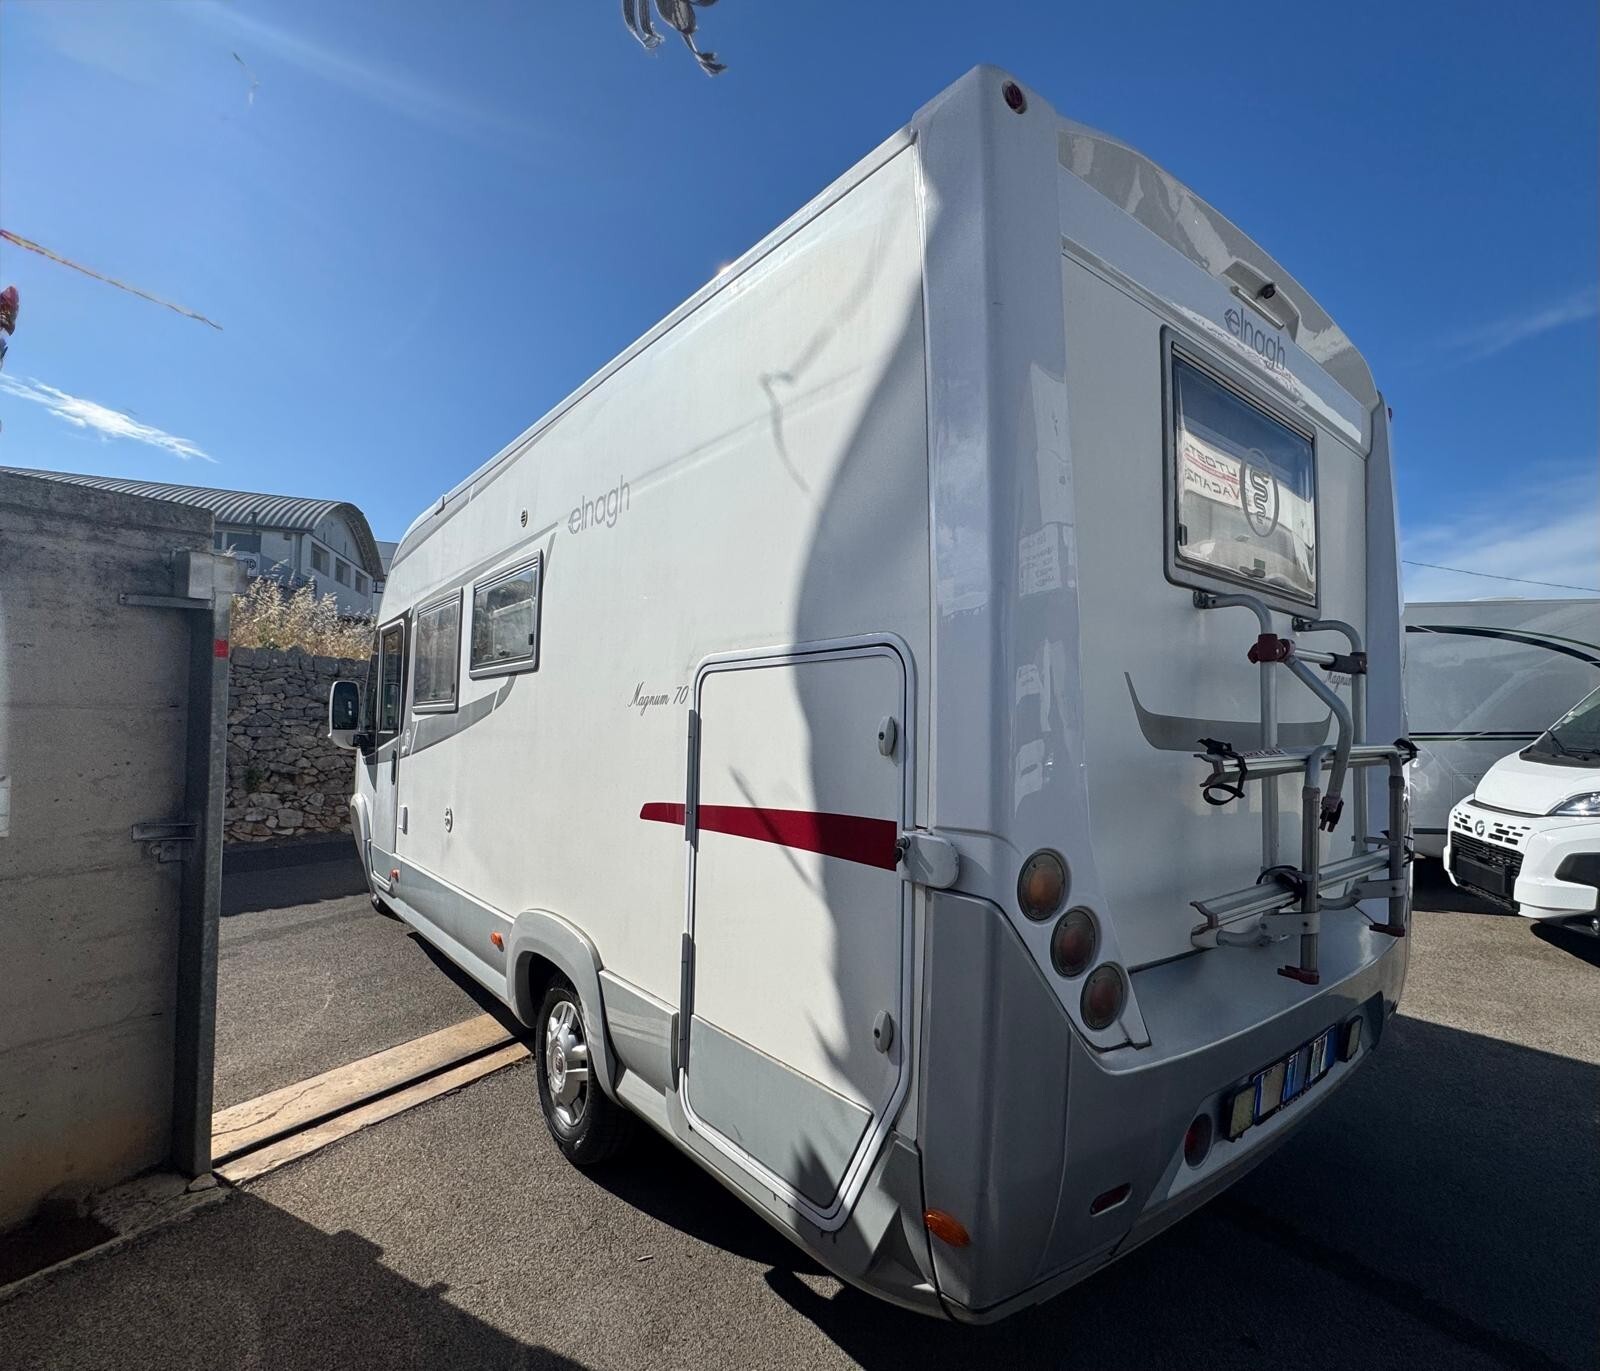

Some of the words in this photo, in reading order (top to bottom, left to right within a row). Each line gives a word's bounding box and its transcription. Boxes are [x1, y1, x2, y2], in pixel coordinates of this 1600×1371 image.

[1224, 308, 1286, 370] elnagh
[567, 473, 630, 535] elnagh
[625, 681, 670, 717] Magnum
[672, 684, 690, 705] 70
